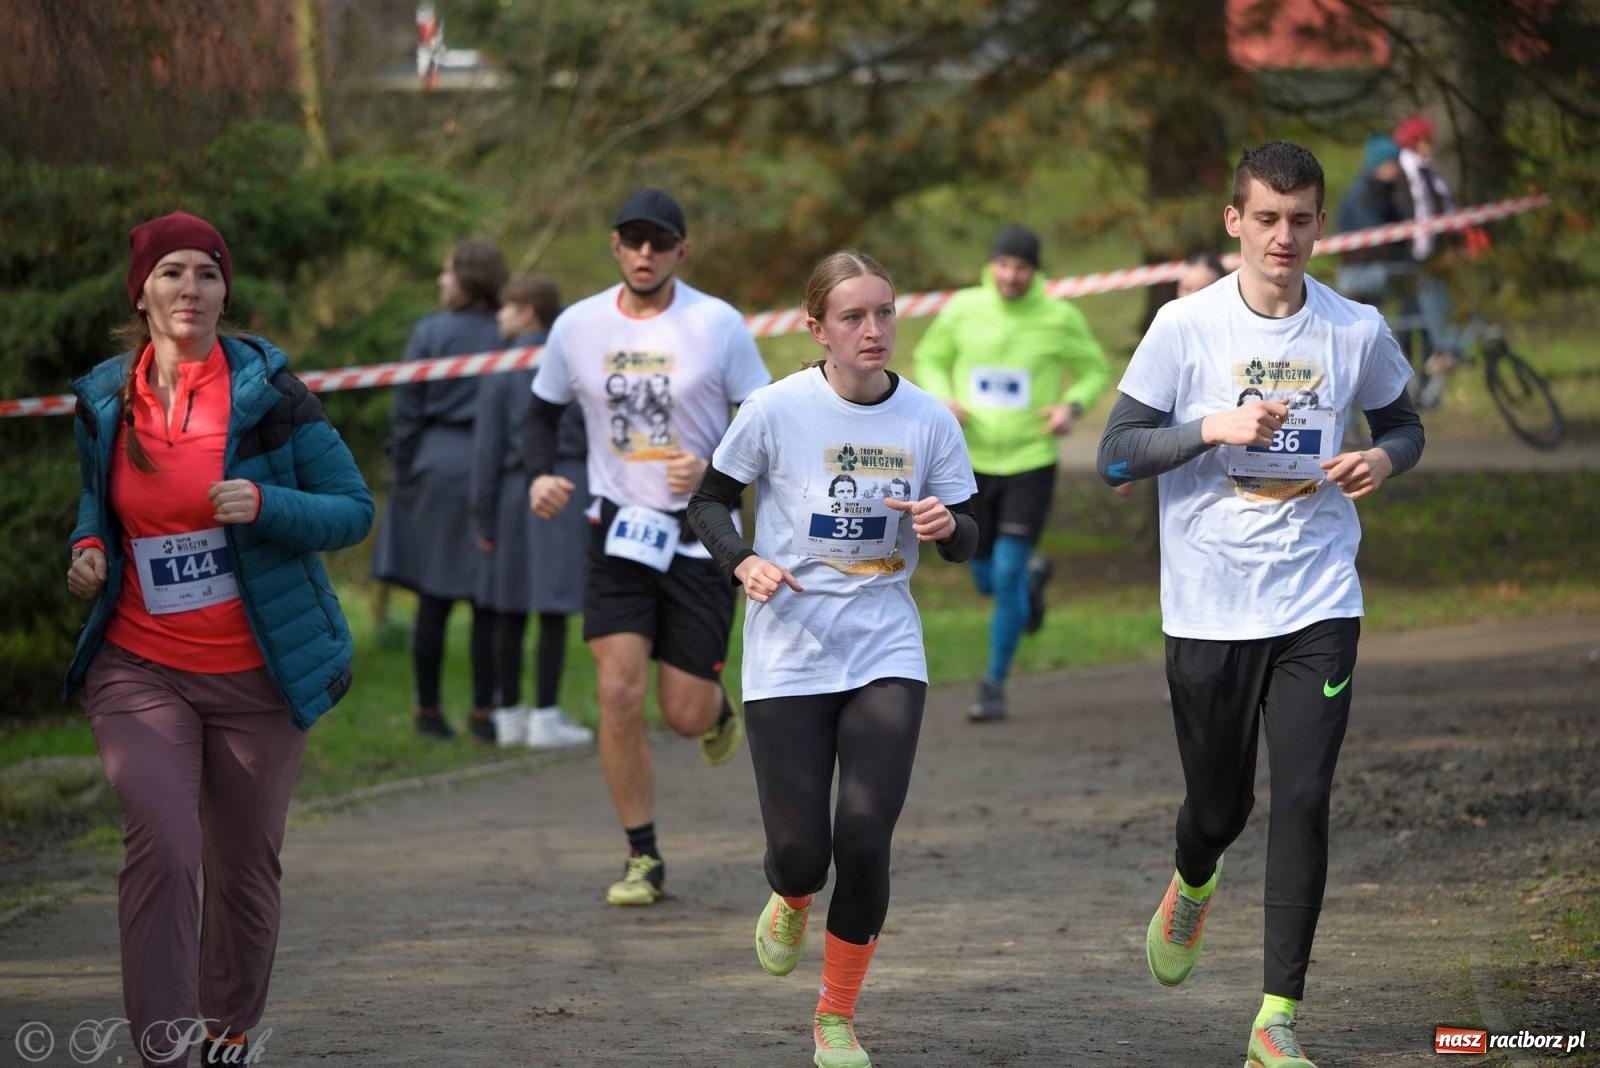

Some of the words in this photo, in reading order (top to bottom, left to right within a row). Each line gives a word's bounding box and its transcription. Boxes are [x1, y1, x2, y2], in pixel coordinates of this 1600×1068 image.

[1269, 369, 1311, 380] WILCZYM
[1269, 430, 1300, 452] 36
[861, 456, 904, 468] WILCZYM
[832, 518, 864, 539] 35
[177, 540, 208, 552] WILCZYM
[165, 552, 218, 582] 144
